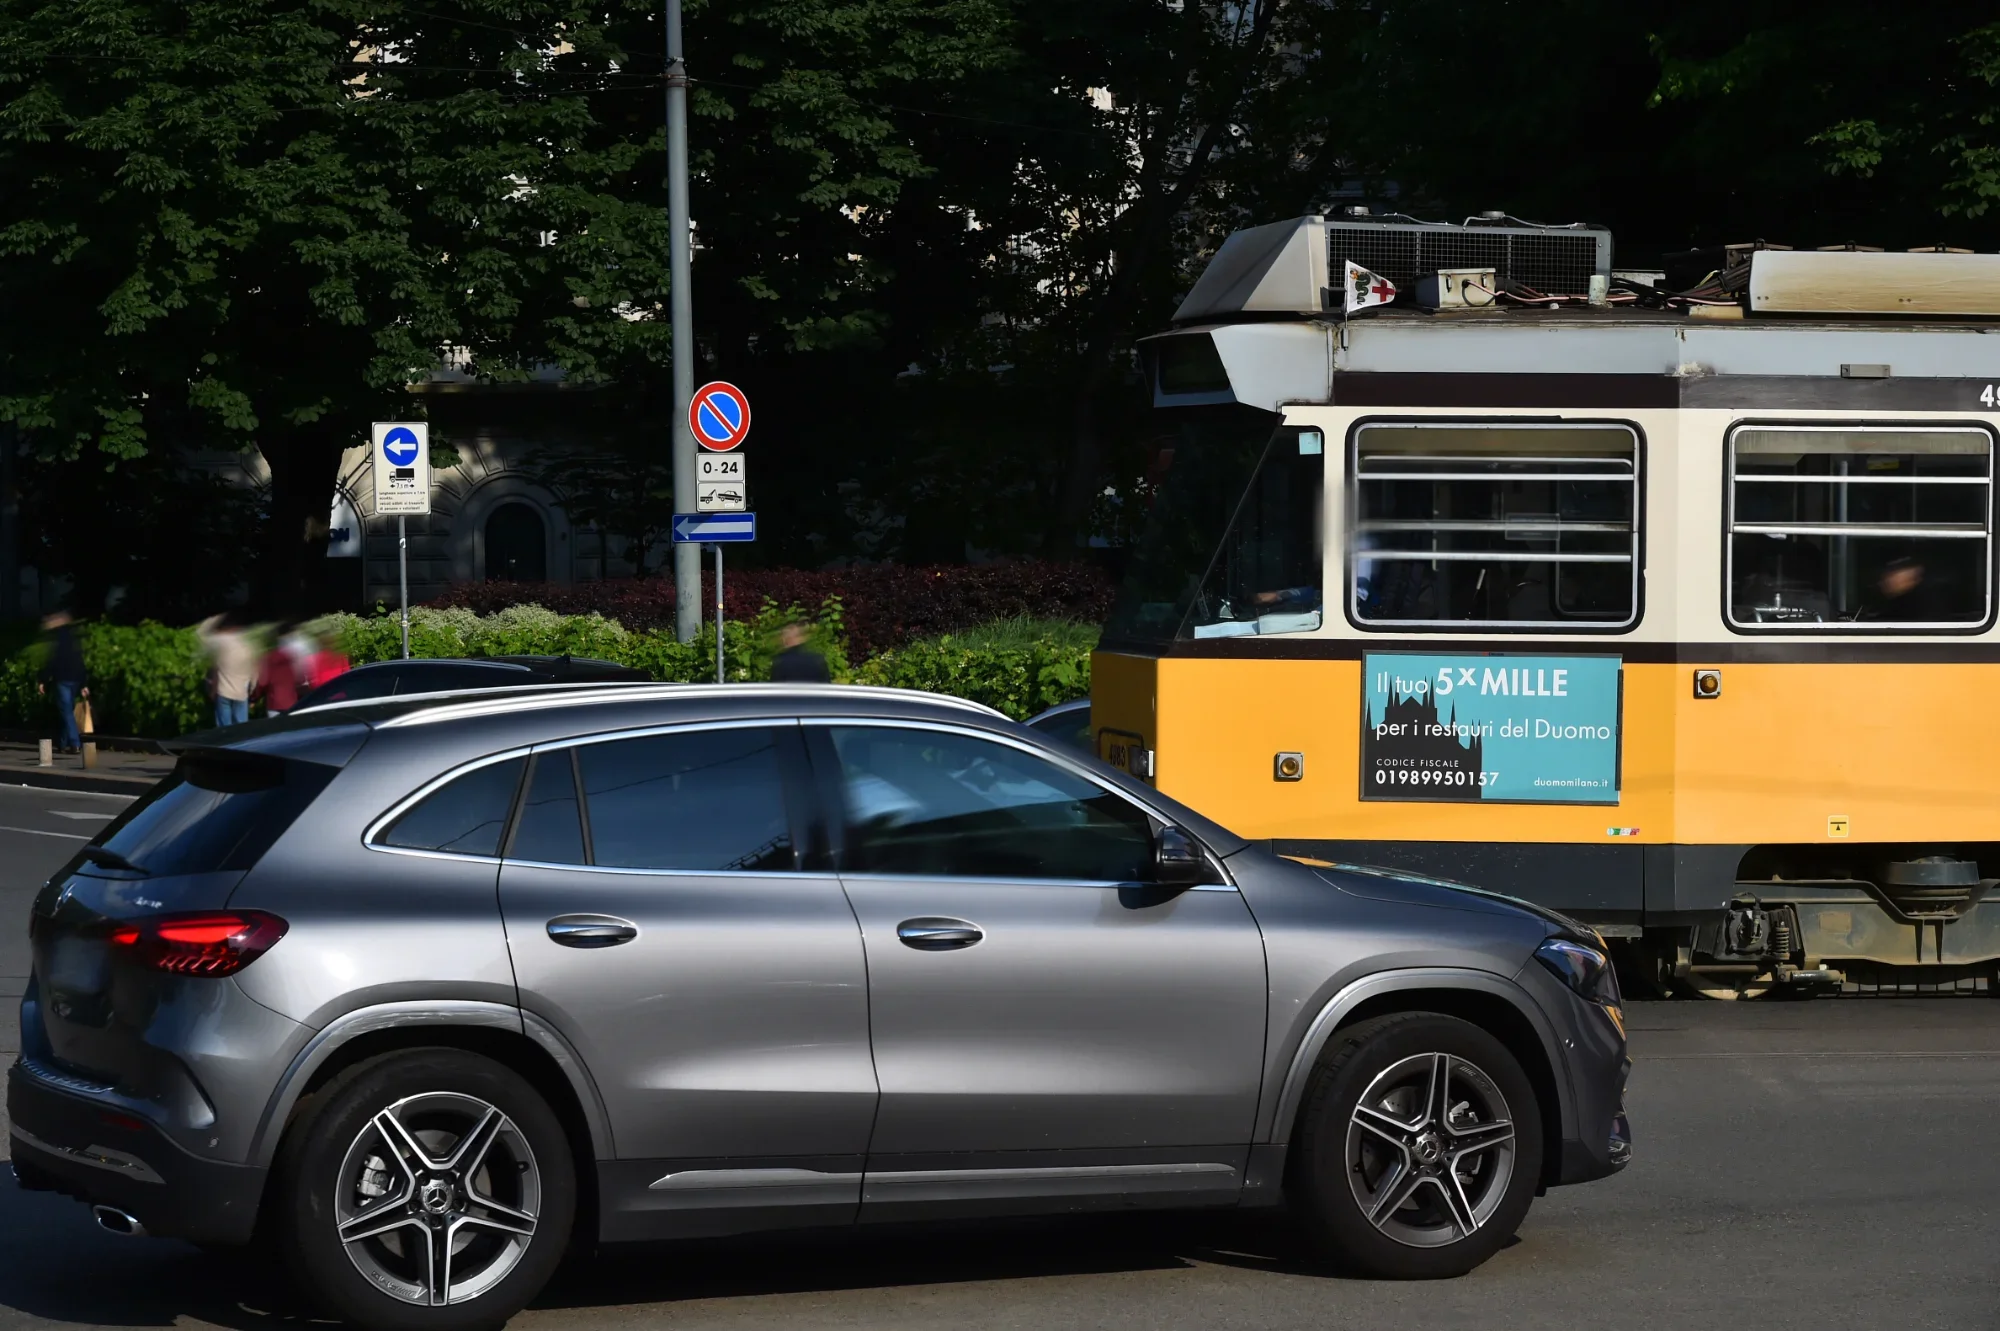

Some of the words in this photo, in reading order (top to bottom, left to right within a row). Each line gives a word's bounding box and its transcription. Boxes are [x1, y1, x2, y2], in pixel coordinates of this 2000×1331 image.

[1980, 384, 2000, 407] 4
[1377, 671, 1388, 693] Il
[1395, 675, 1429, 694] tuo
[1376, 722, 1408, 741] per
[1413, 719, 1418, 736] i
[1424, 720, 1493, 738] restauri
[1500, 718, 1528, 738] del
[1535, 718, 1611, 740] Duomo
[1376, 758, 1415, 767] CODICE
[1420, 759, 1459, 768] FISCALE
[1375, 769, 1499, 786] 01989950157
[1534, 777, 1608, 788] duomomilano.it
